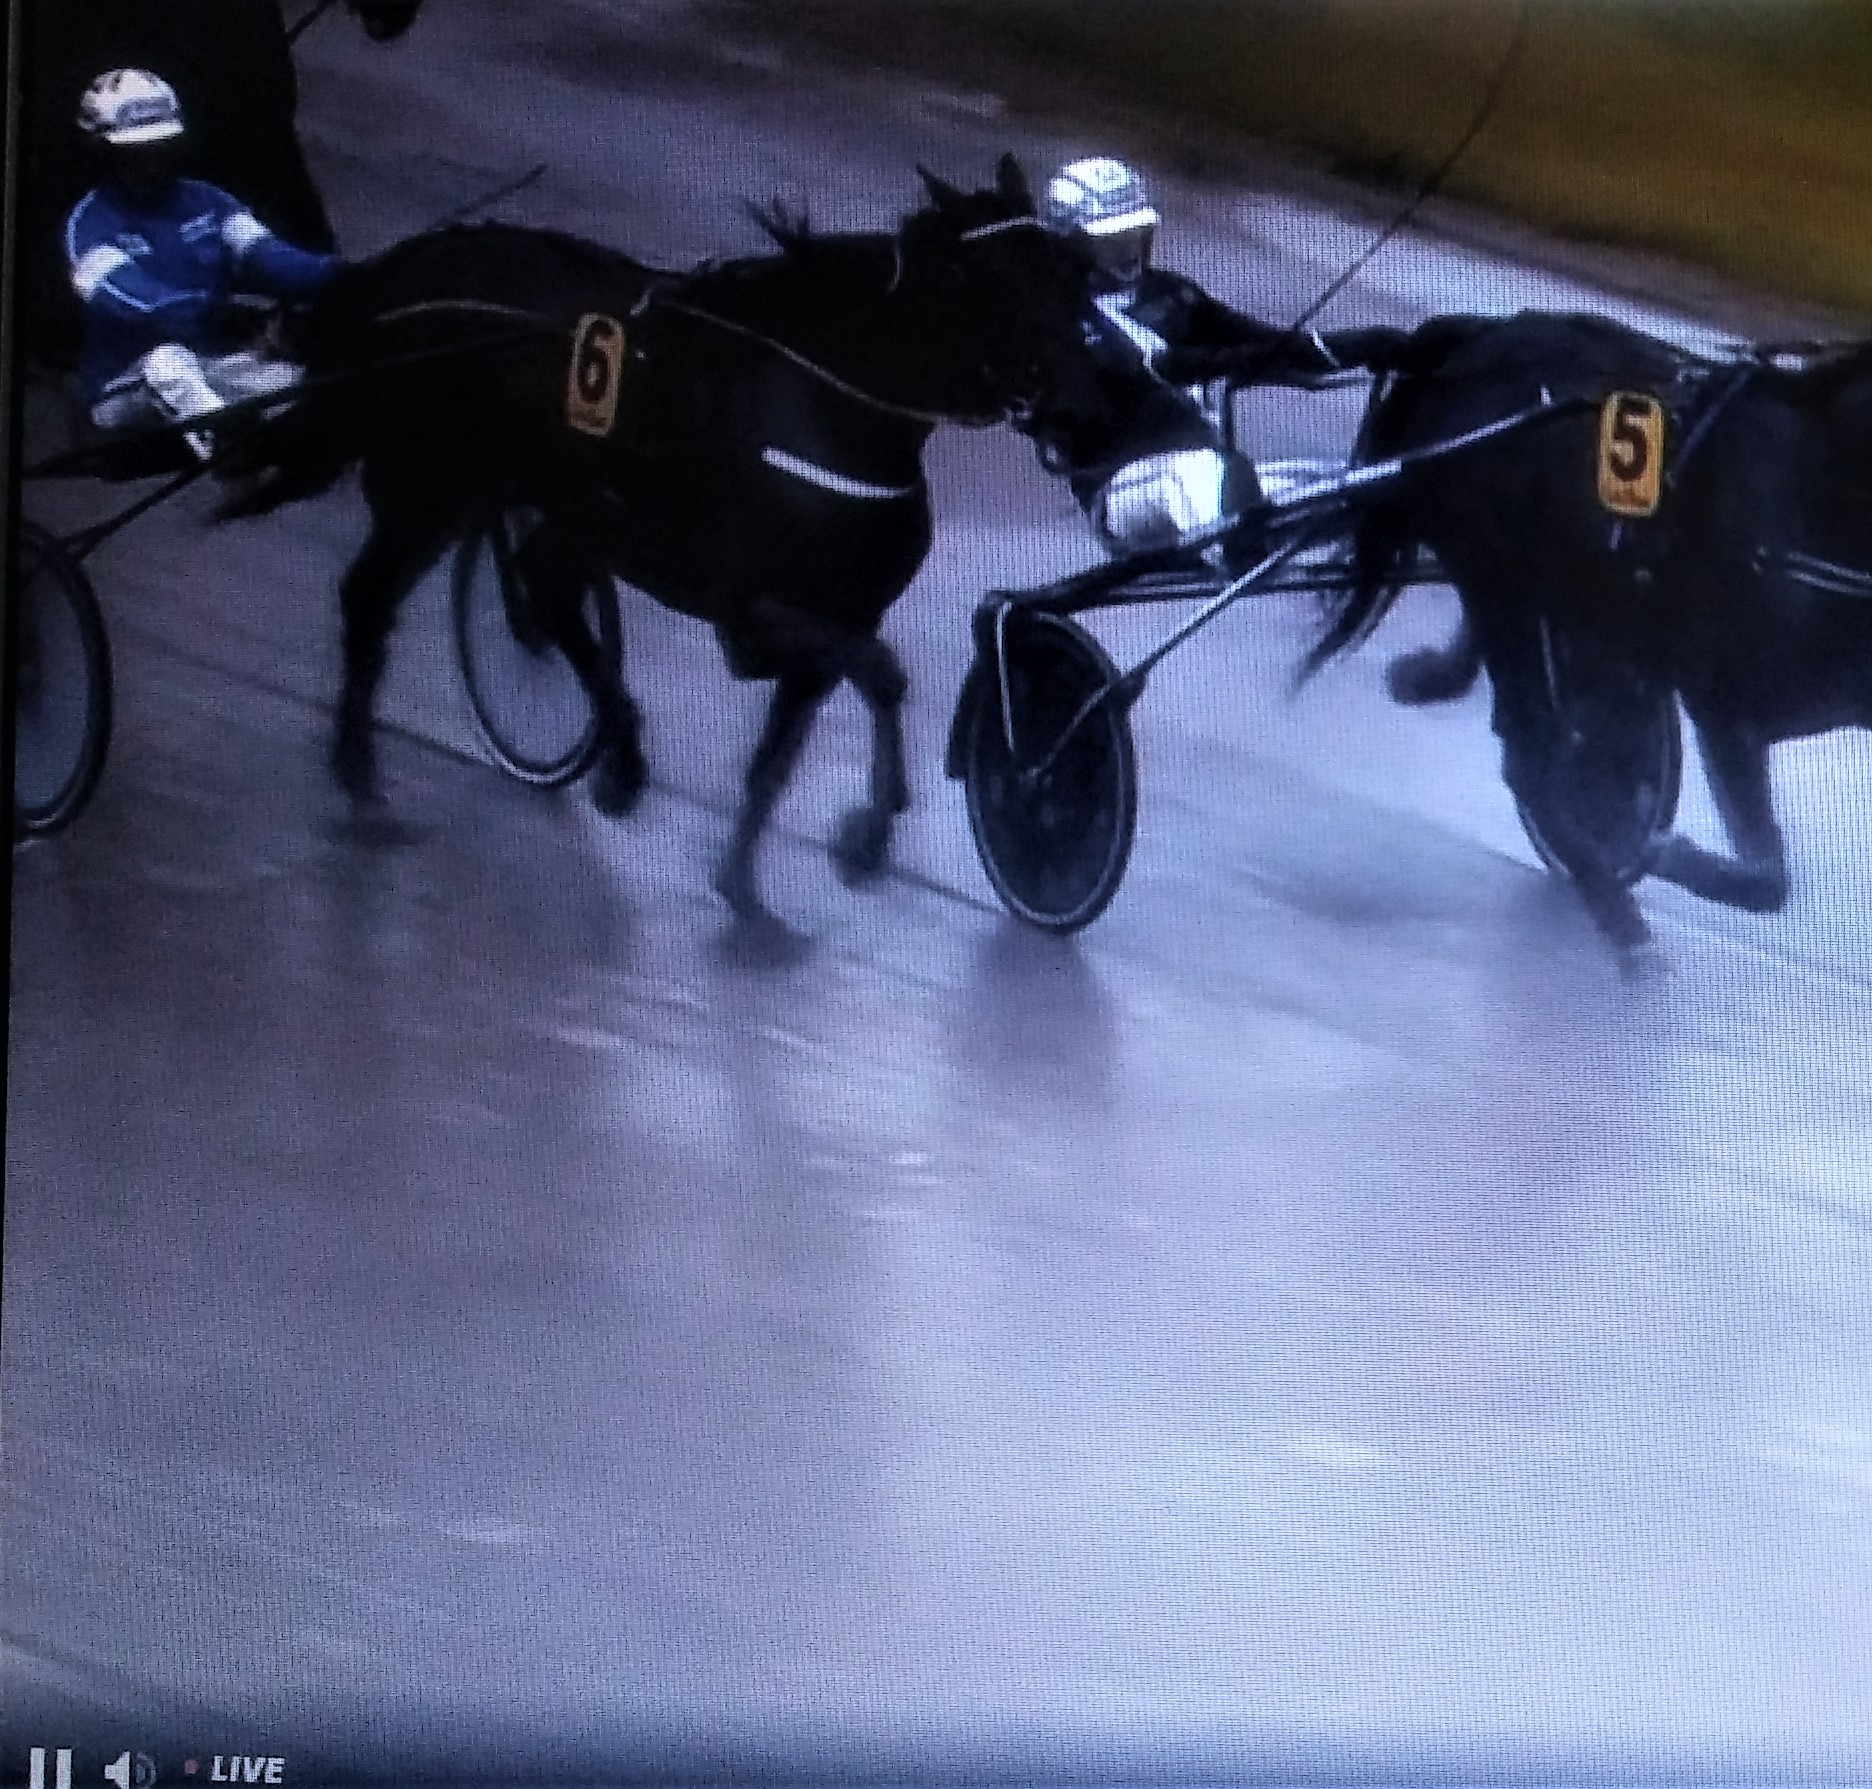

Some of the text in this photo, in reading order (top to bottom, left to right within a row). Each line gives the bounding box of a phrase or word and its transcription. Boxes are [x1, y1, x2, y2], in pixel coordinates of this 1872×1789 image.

[578, 320, 616, 403] 6
[1608, 398, 1651, 482] 5
[211, 1755, 285, 1784] LIVE
